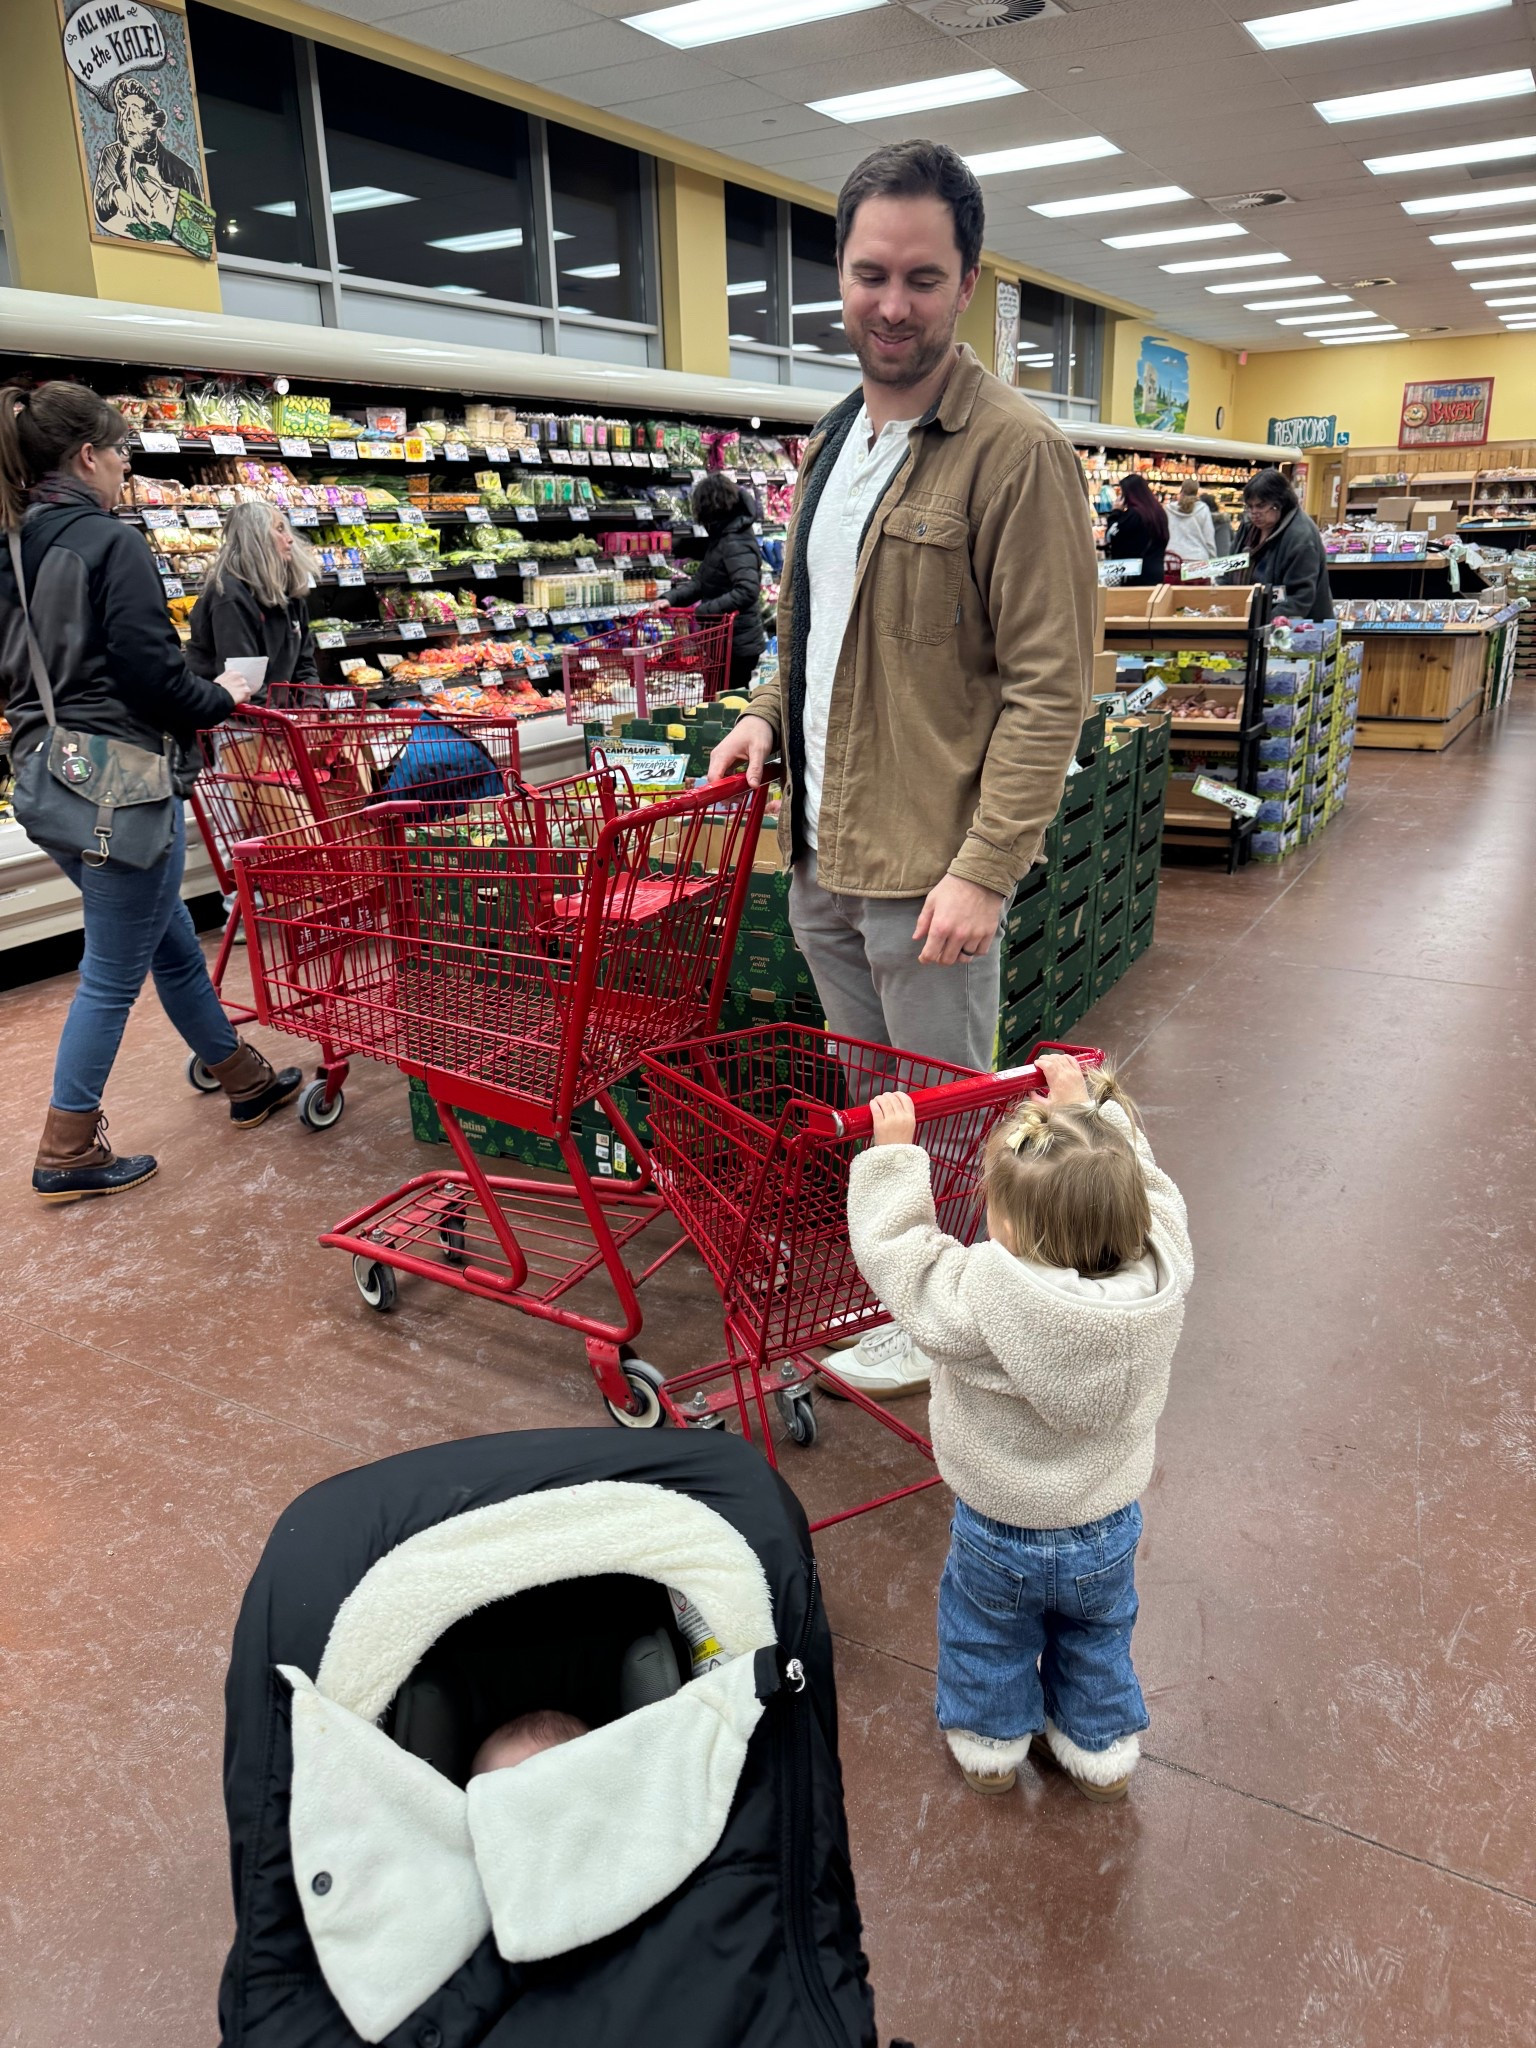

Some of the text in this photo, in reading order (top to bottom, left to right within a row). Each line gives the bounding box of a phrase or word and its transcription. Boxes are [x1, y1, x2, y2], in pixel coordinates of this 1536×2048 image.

[77, 4, 126, 40] ALL HAIL
[78, 23, 164, 81] to the KALE!
[1273, 417, 1330, 446] RESTROOMS
[605, 747, 661, 755] CANTALOUPE
[632, 761, 678, 771] PINEAPPLES
[753, 897, 768, 905] with
[752, 960, 767, 968] with
